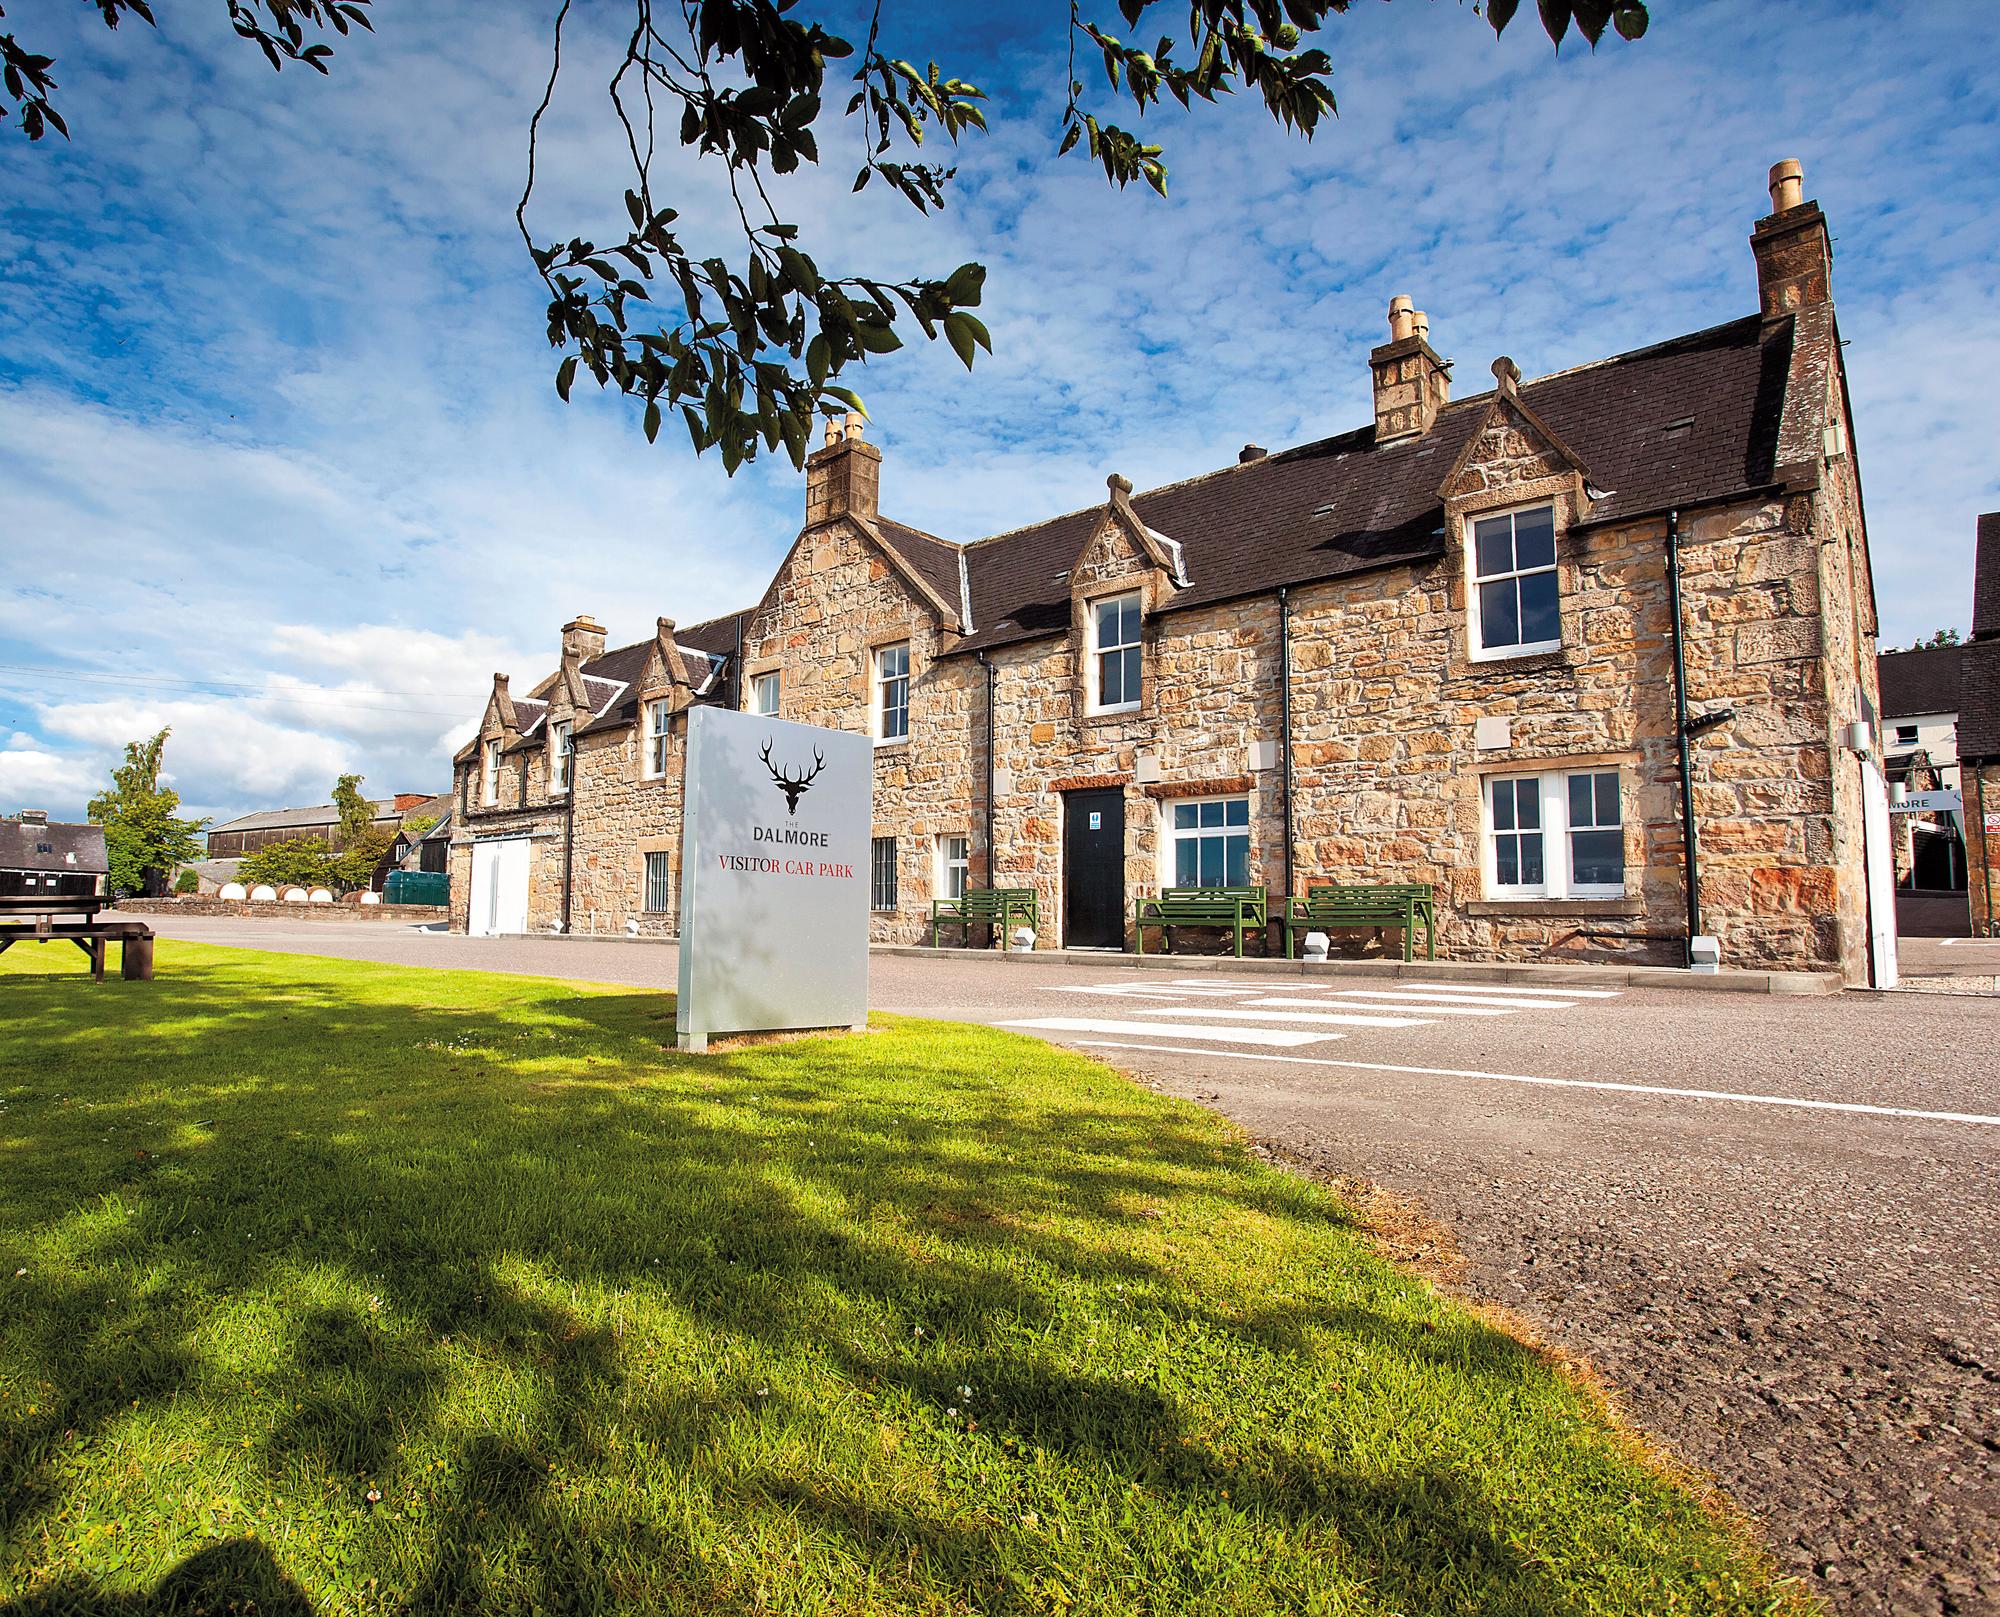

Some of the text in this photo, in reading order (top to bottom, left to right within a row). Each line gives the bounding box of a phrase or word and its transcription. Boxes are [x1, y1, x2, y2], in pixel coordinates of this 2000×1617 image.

[785, 820, 799, 828] THE
[753, 826, 829, 847] DALMORE
[719, 854, 855, 878] VISITOR CAR PARK
